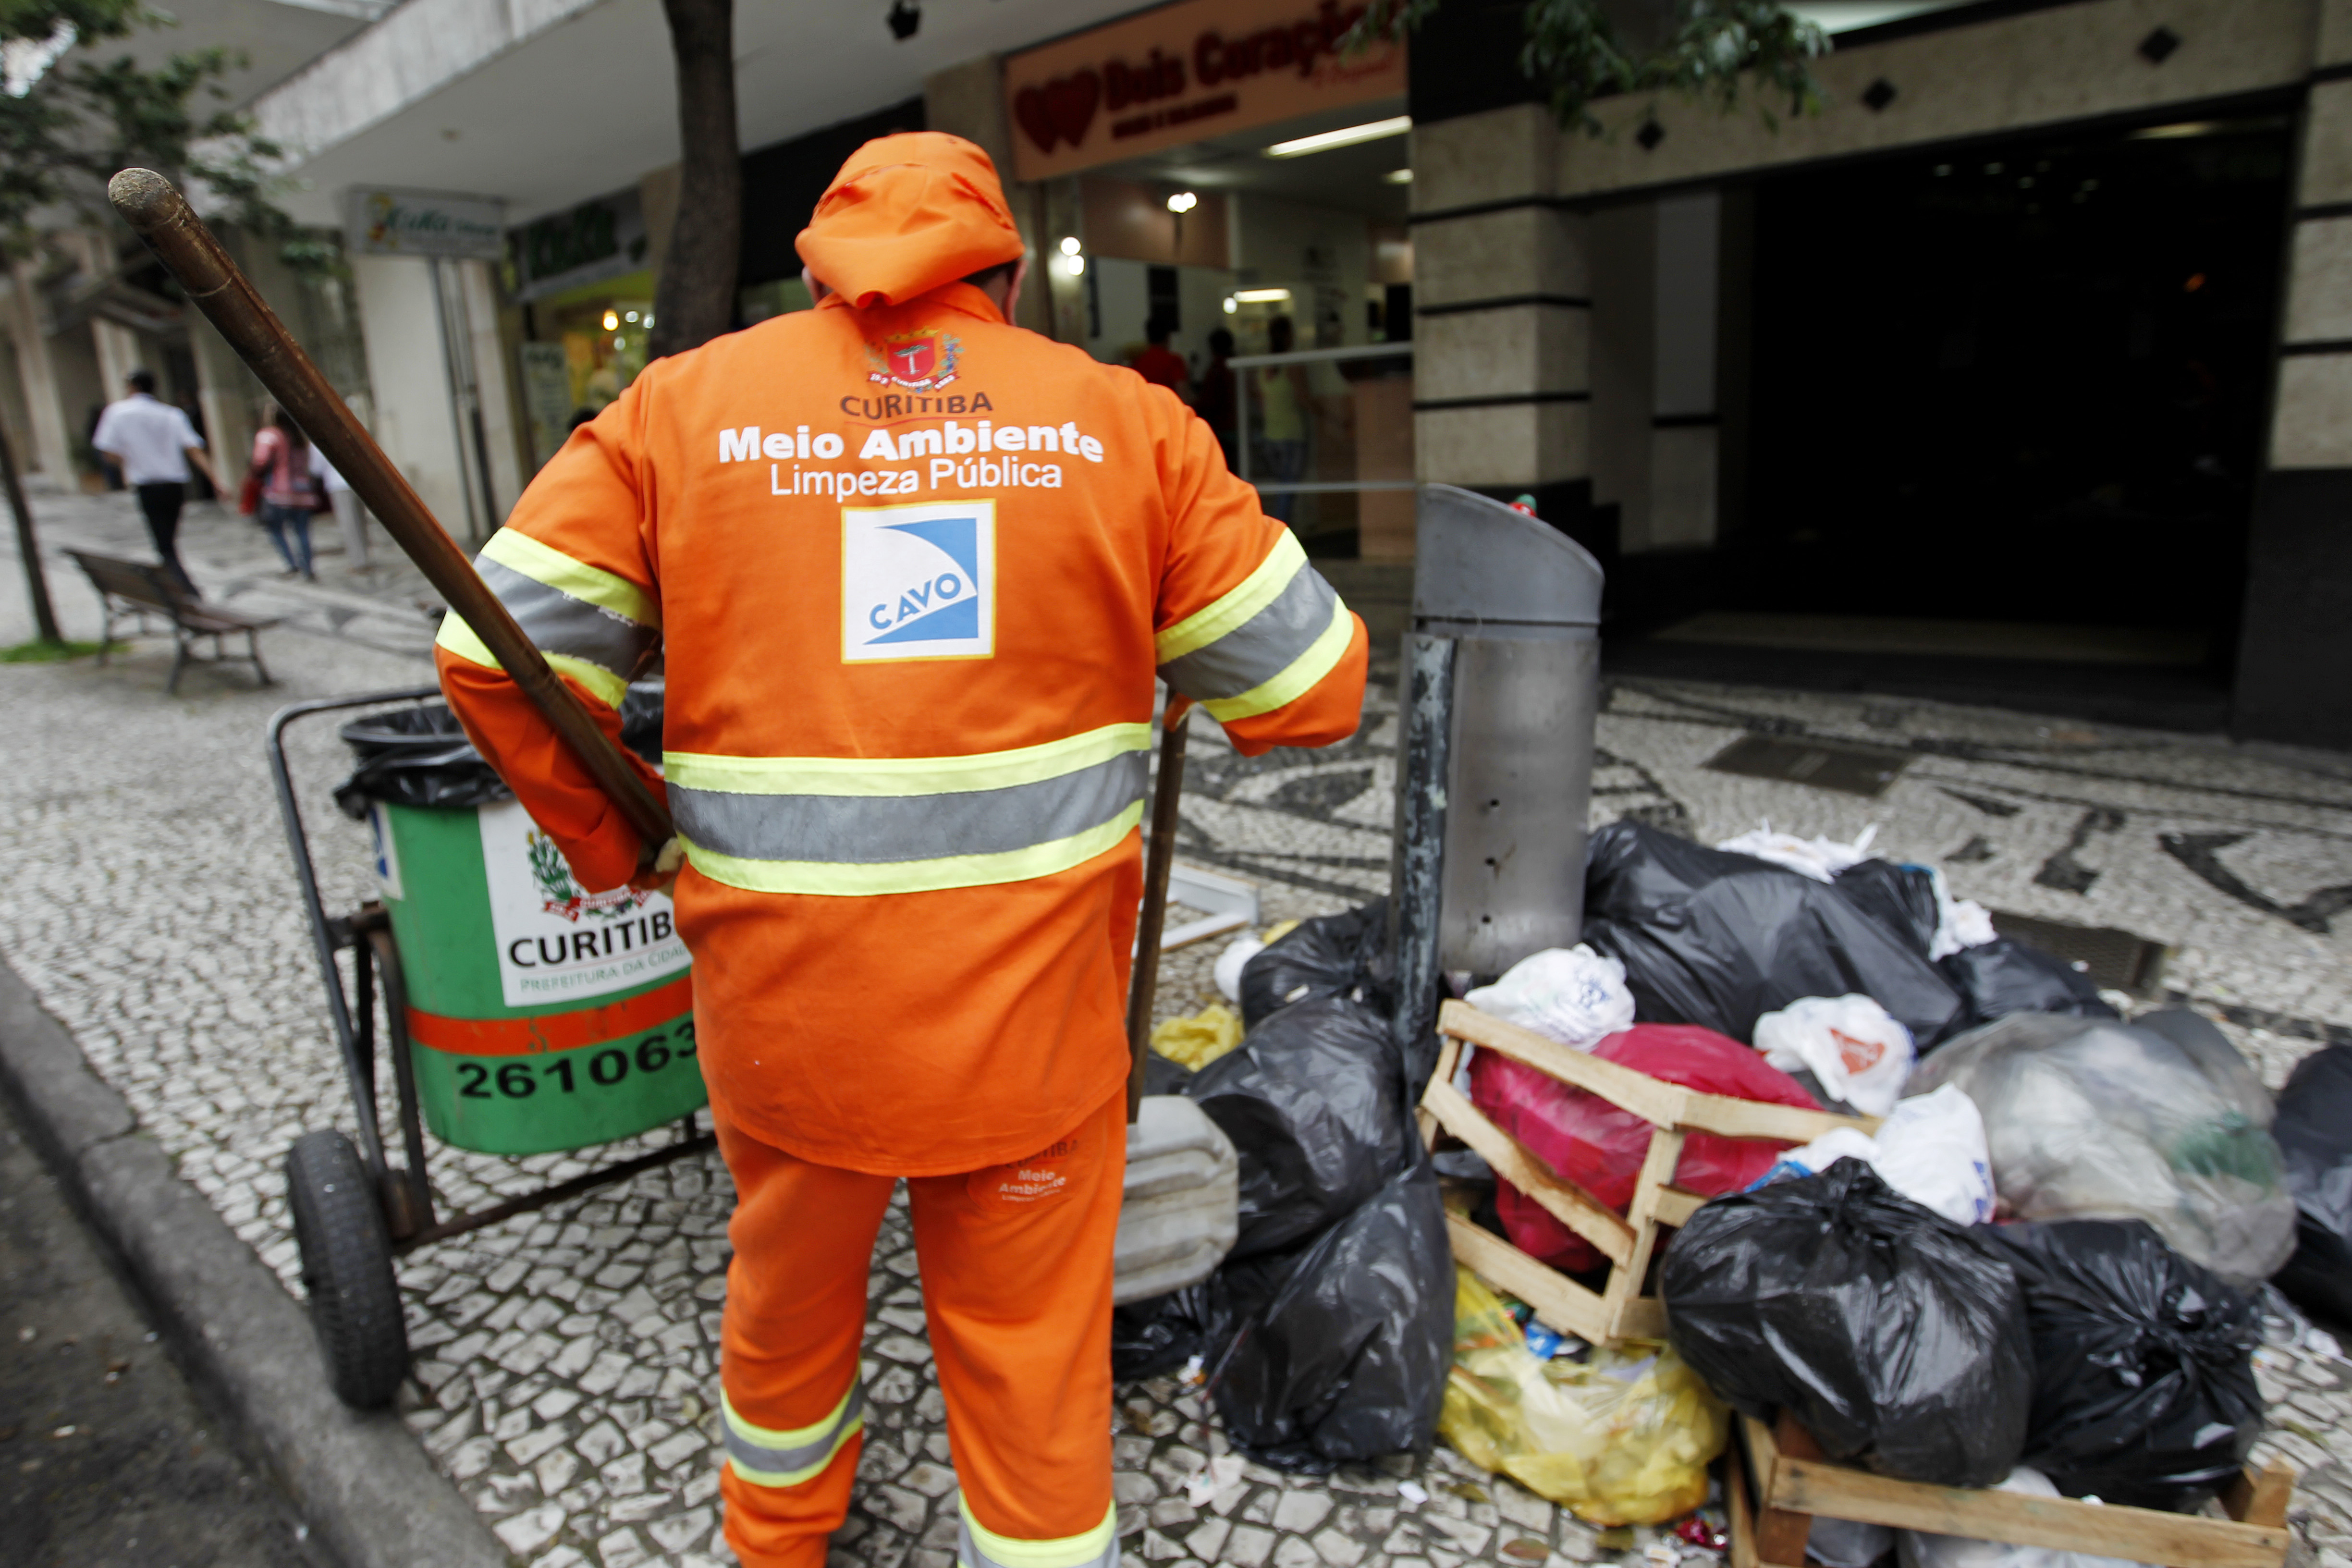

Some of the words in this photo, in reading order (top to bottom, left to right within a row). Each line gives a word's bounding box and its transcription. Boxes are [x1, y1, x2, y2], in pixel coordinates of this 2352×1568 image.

[840, 391, 994, 420] CURITIBA
[719, 425, 845, 463] Meio
[859, 420, 1104, 463] Ambiente
[771, 464, 919, 503] Limpeza
[930, 456, 1062, 490] Pública
[869, 572, 961, 630] CAVO
[508, 910, 673, 968] CURITIB
[520, 966, 619, 993] PREFEITURA
[623, 959, 645, 976] DA
[647, 943, 690, 968] CIDAD
[456, 1020, 697, 1099] 261063
